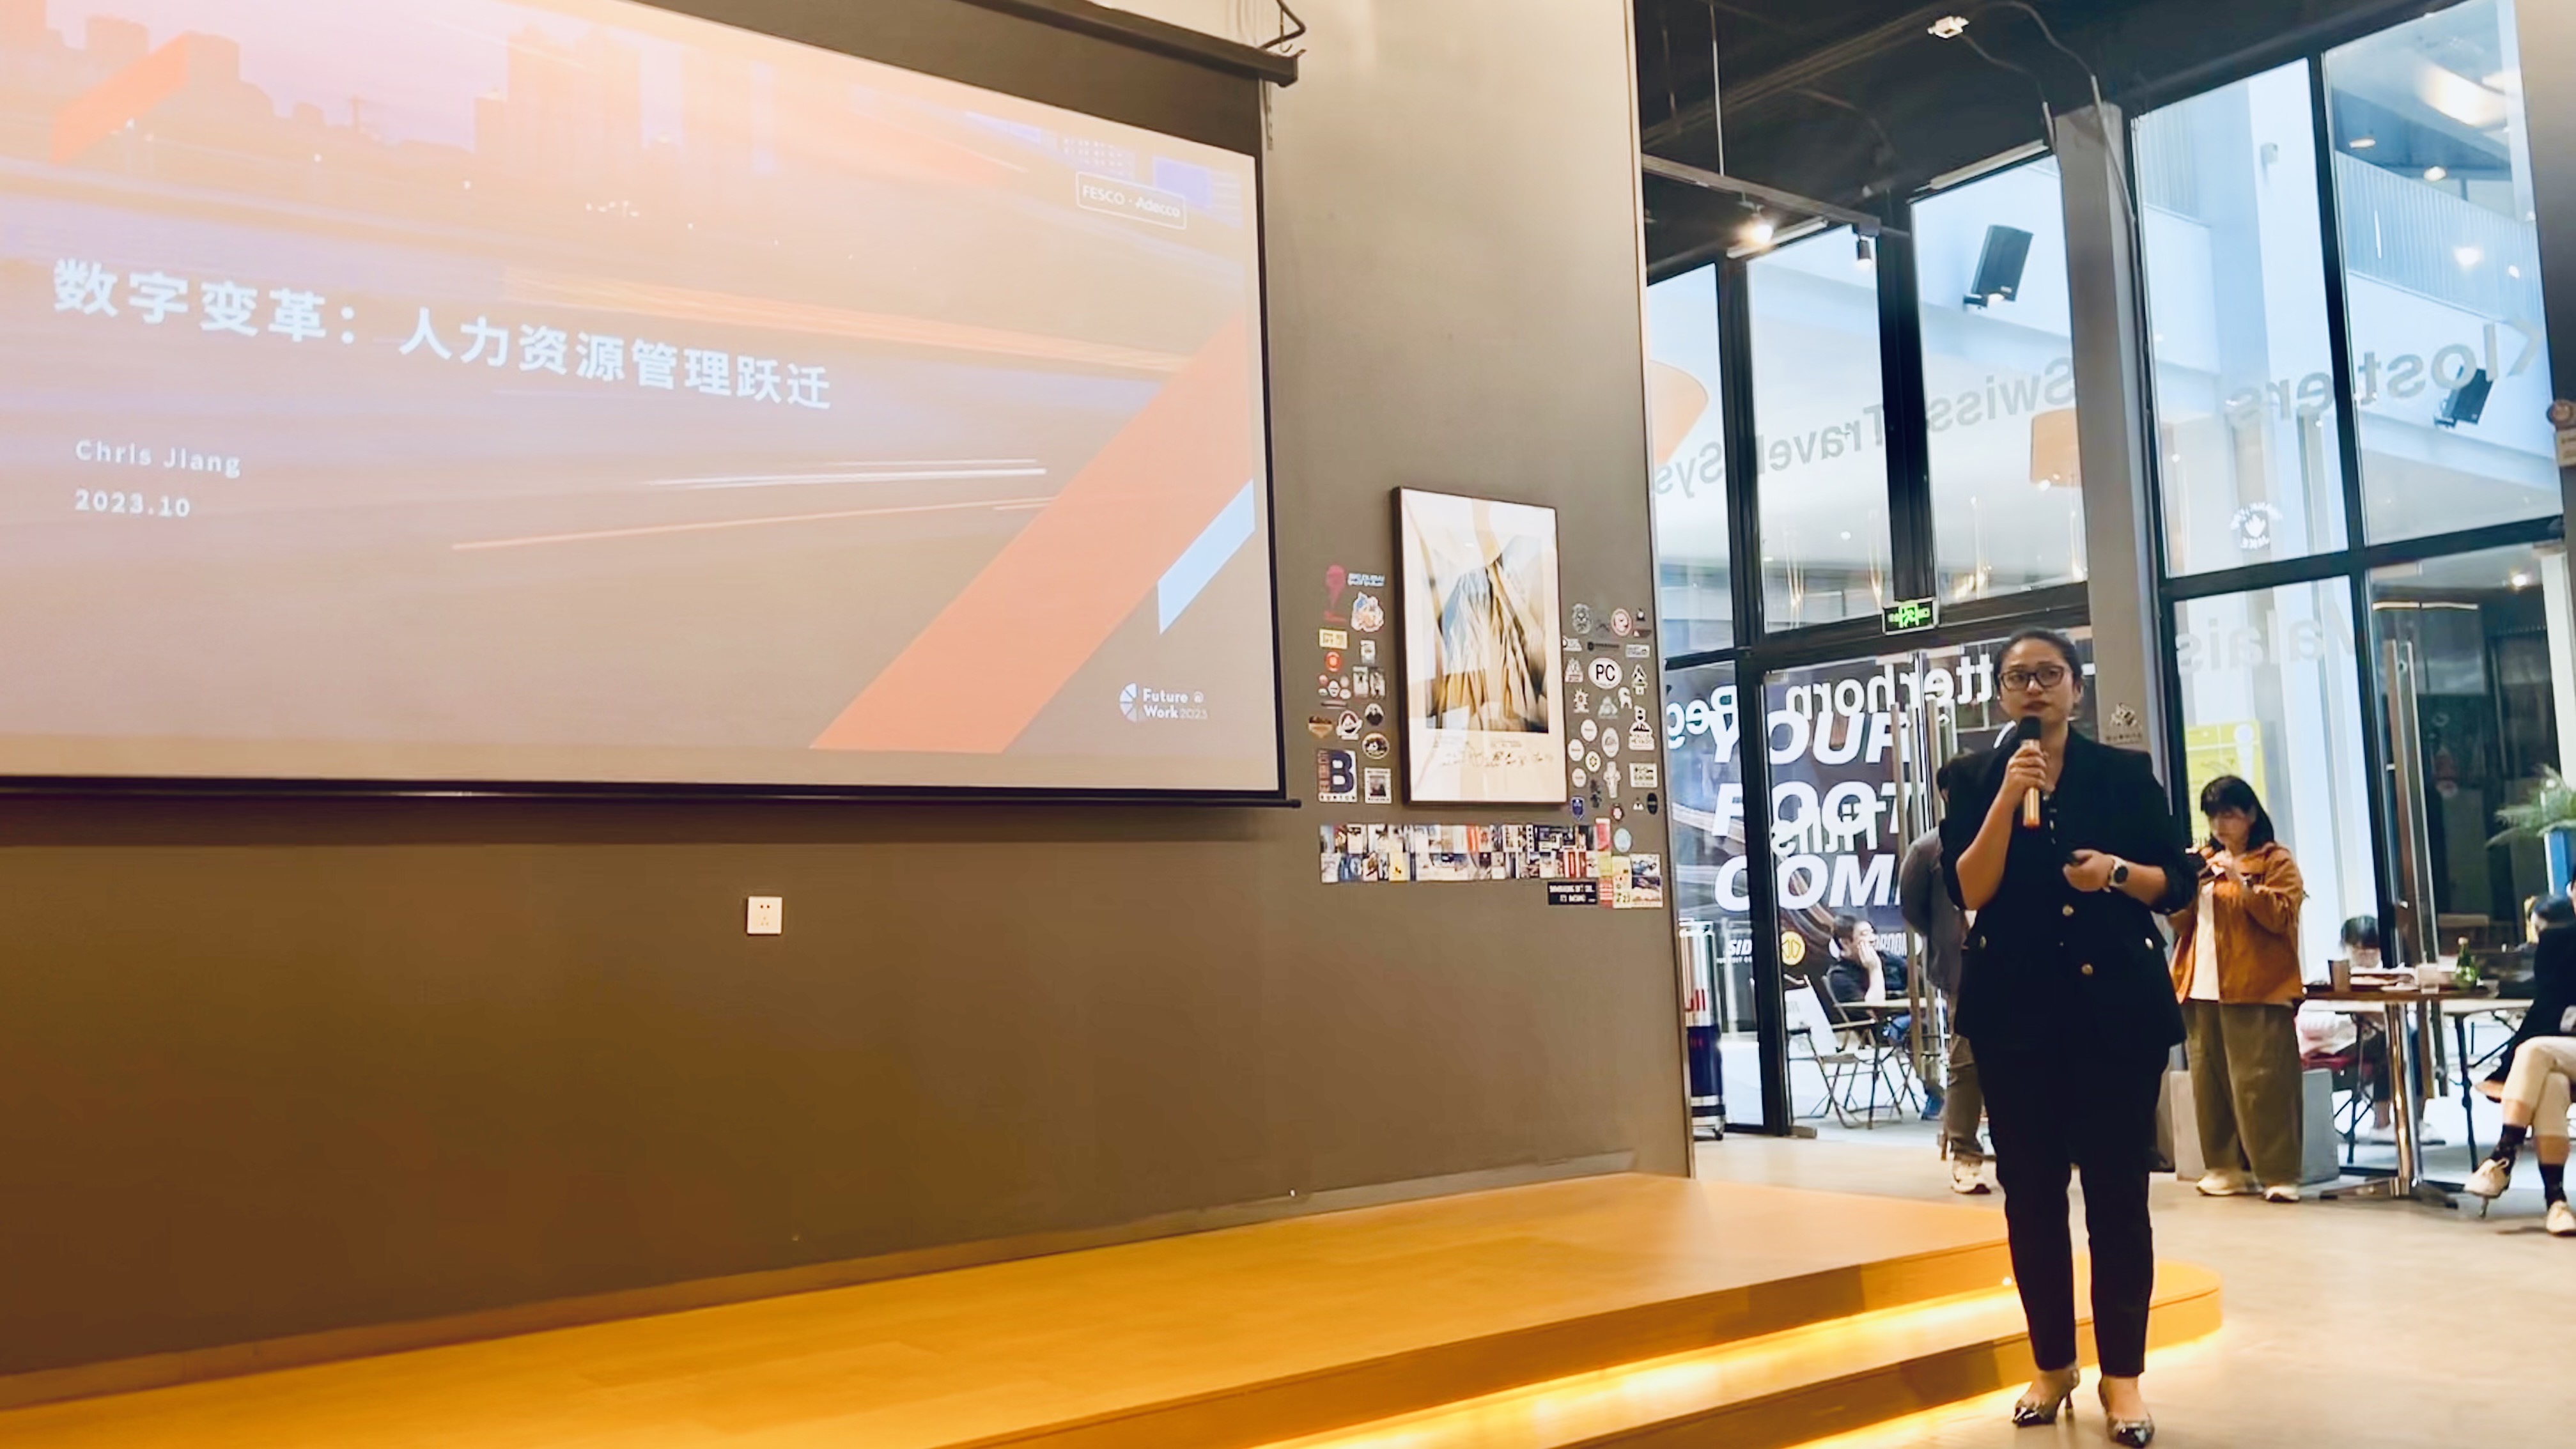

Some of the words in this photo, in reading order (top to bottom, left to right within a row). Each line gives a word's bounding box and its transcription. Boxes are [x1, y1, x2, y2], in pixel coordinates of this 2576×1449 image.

[1082, 185, 1126, 205] FESCO
[1135, 196, 1181, 218] Adecco
[75, 439, 152, 465] Chris
[163, 446, 242, 479] Jiang
[75, 489, 191, 517] 2023.10
[1595, 664, 1616, 681] PC
[1142, 688, 1189, 704] Future
[1193, 691, 1205, 704] @
[1143, 704, 1179, 718] Work
[1329, 749, 1354, 794] B
[1714, 854, 1901, 911] COM
